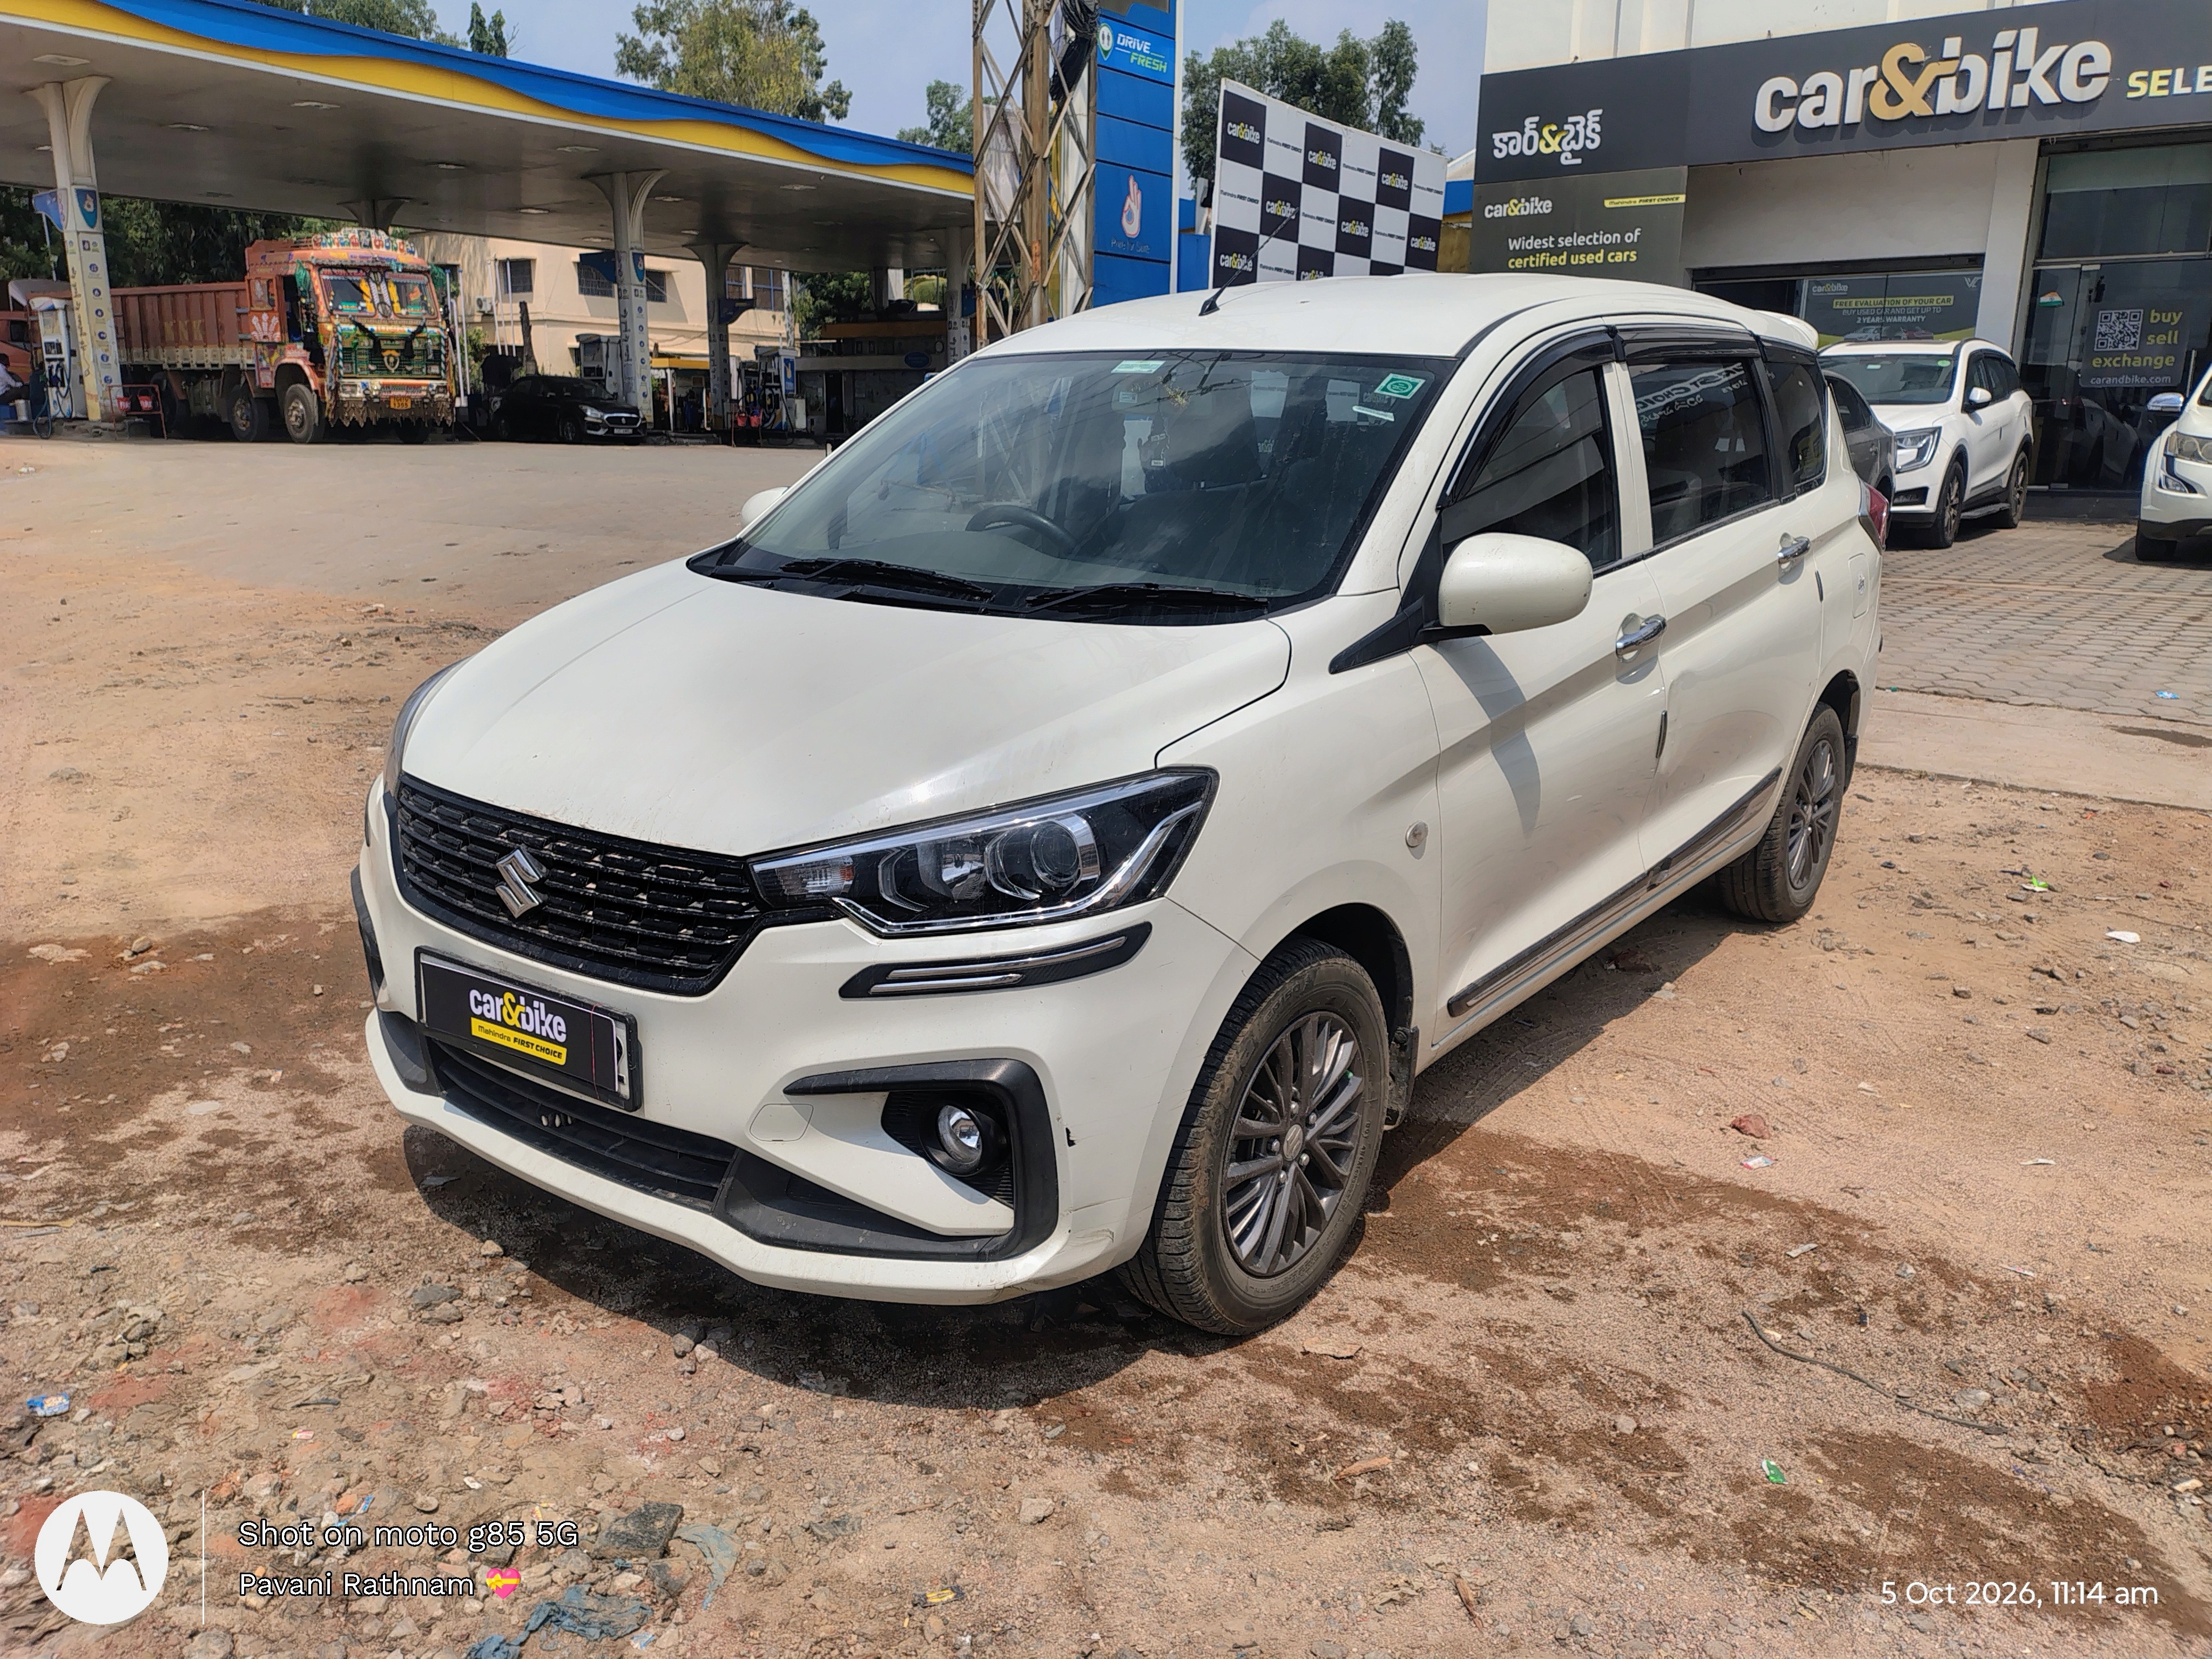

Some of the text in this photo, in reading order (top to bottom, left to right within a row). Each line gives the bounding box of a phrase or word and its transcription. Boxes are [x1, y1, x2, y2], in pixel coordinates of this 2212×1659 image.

[1117, 33, 1151, 53] DRIVE
[1130, 52, 1167, 72] FRESH
[1754, 27, 2112, 132] car&bike
[1227, 122, 1260, 144] car&bike
[1308, 151, 1337, 170] car&bike
[1381, 172, 1408, 190] car&bike
[1485, 197, 1553, 218] car&bike
[1341, 220, 1369, 237] car&bike
[1411, 236, 1435, 251] car&bike
[1508, 228, 1641, 251] Widest selection of
[1508, 249, 1637, 269] certified used cars
[1812, 283, 1848, 293] car&bike
[2149, 308, 2182, 326] buy
[2146, 330, 2178, 345] sell
[2092, 353, 2175, 369] exchange
[2090, 374, 2171, 384] carandbike.com
[470, 989, 567, 1042] car&bike
[478, 1025, 563, 1059] Mahindra FIRST CHOICE
